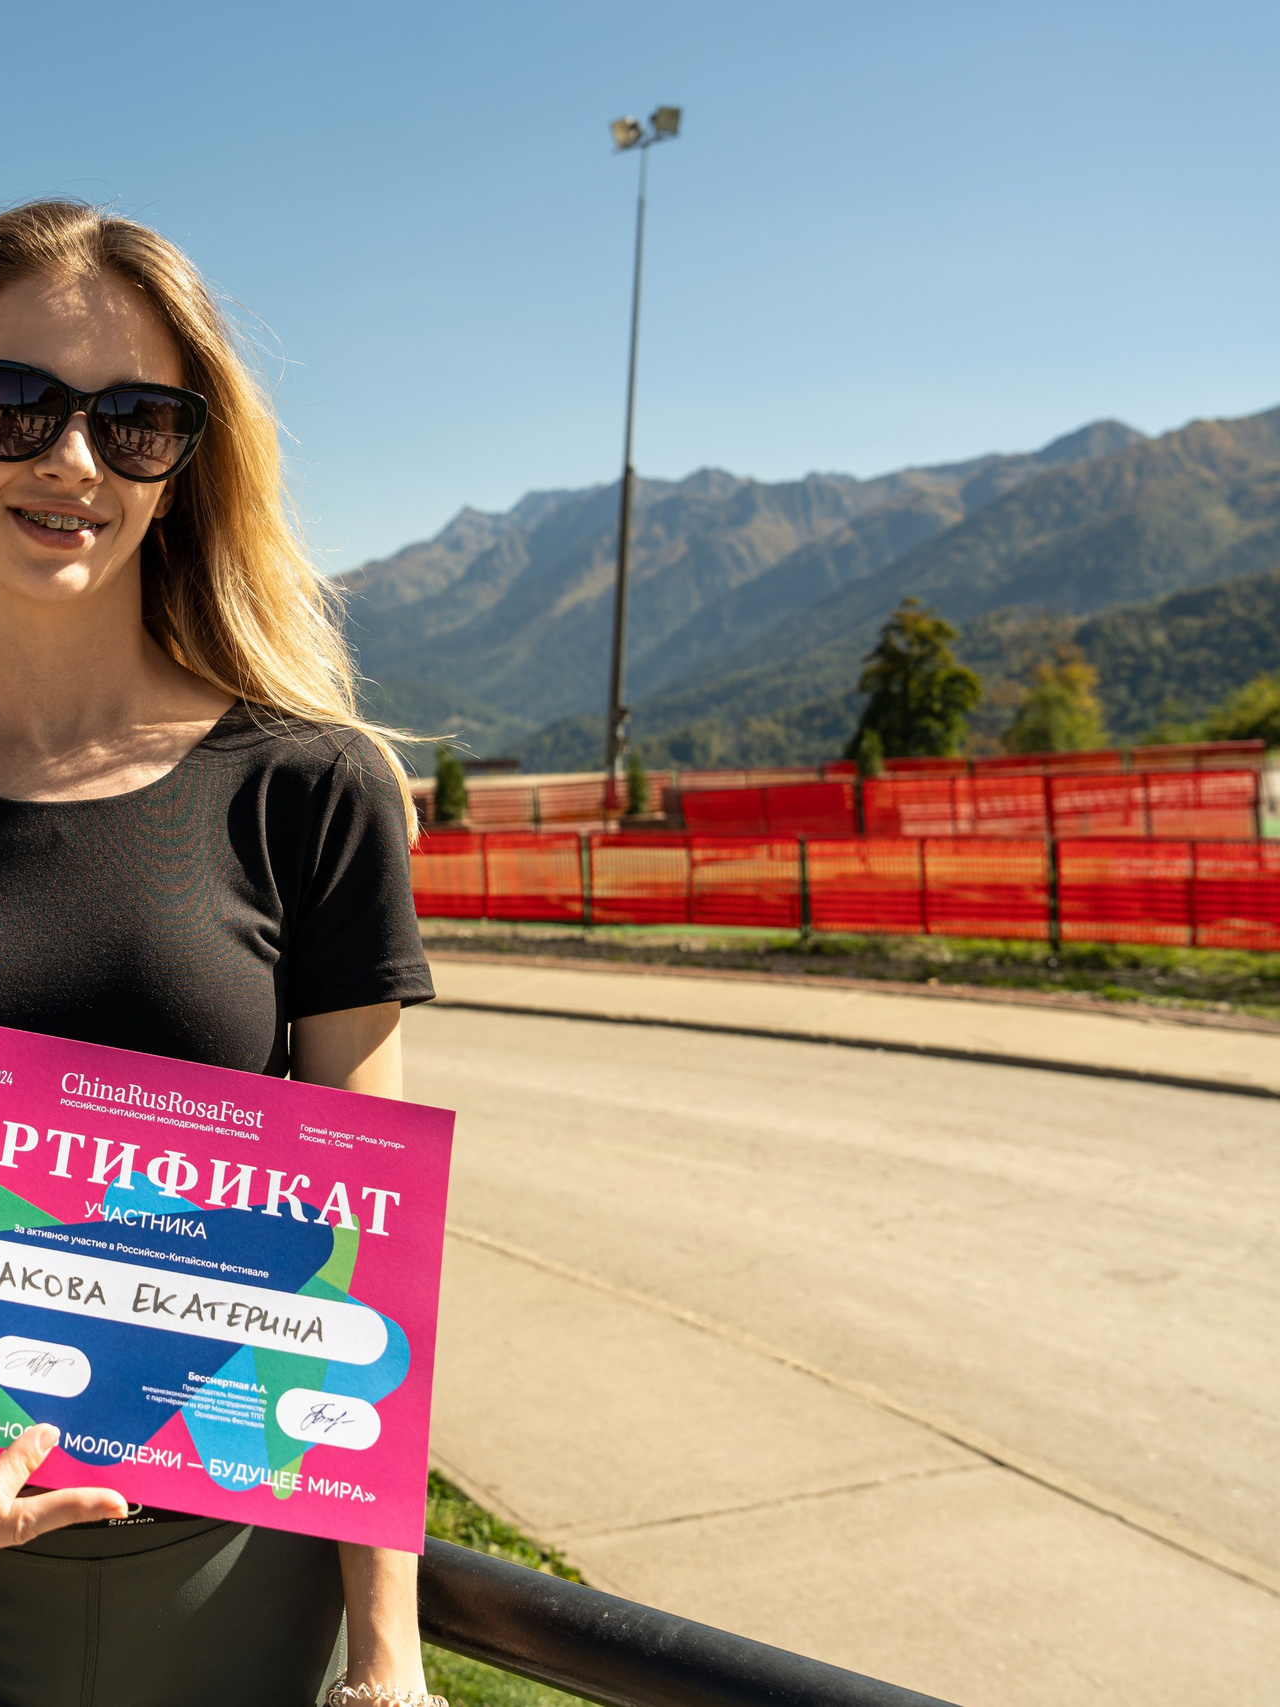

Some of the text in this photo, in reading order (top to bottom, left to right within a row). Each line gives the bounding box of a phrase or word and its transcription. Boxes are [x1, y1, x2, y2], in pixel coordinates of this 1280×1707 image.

[60, 1098, 260, 1141] РОССИЙСКО-КИТАЙСКИЙ МОЛОДЕЖНЫЙ ФЕСТИВАЛЬ
[61, 1072, 264, 1129] ChinaRusRosaFest
[300, 1123, 405, 1150] Горный курорт «Роза Хутор»
[334, 1139, 353, 1149] Сочи
[84, 1200, 207, 1240] УЧАСТНИКА
[14, 1223, 269, 1279] За активное участие в Российско-Китайском фестивале
[132, 1283, 323, 1343] ЕКАТЕРИНА
[188, 1371, 250, 1391] Бессмертная
[64, 1432, 182, 1470] МОЛОДЕЖИ
[207, 1458, 303, 1492] БУДУЩЕЕ
[307, 1476, 376, 1503] МИРА»
[108, 1517, 155, 1526] Stretch
